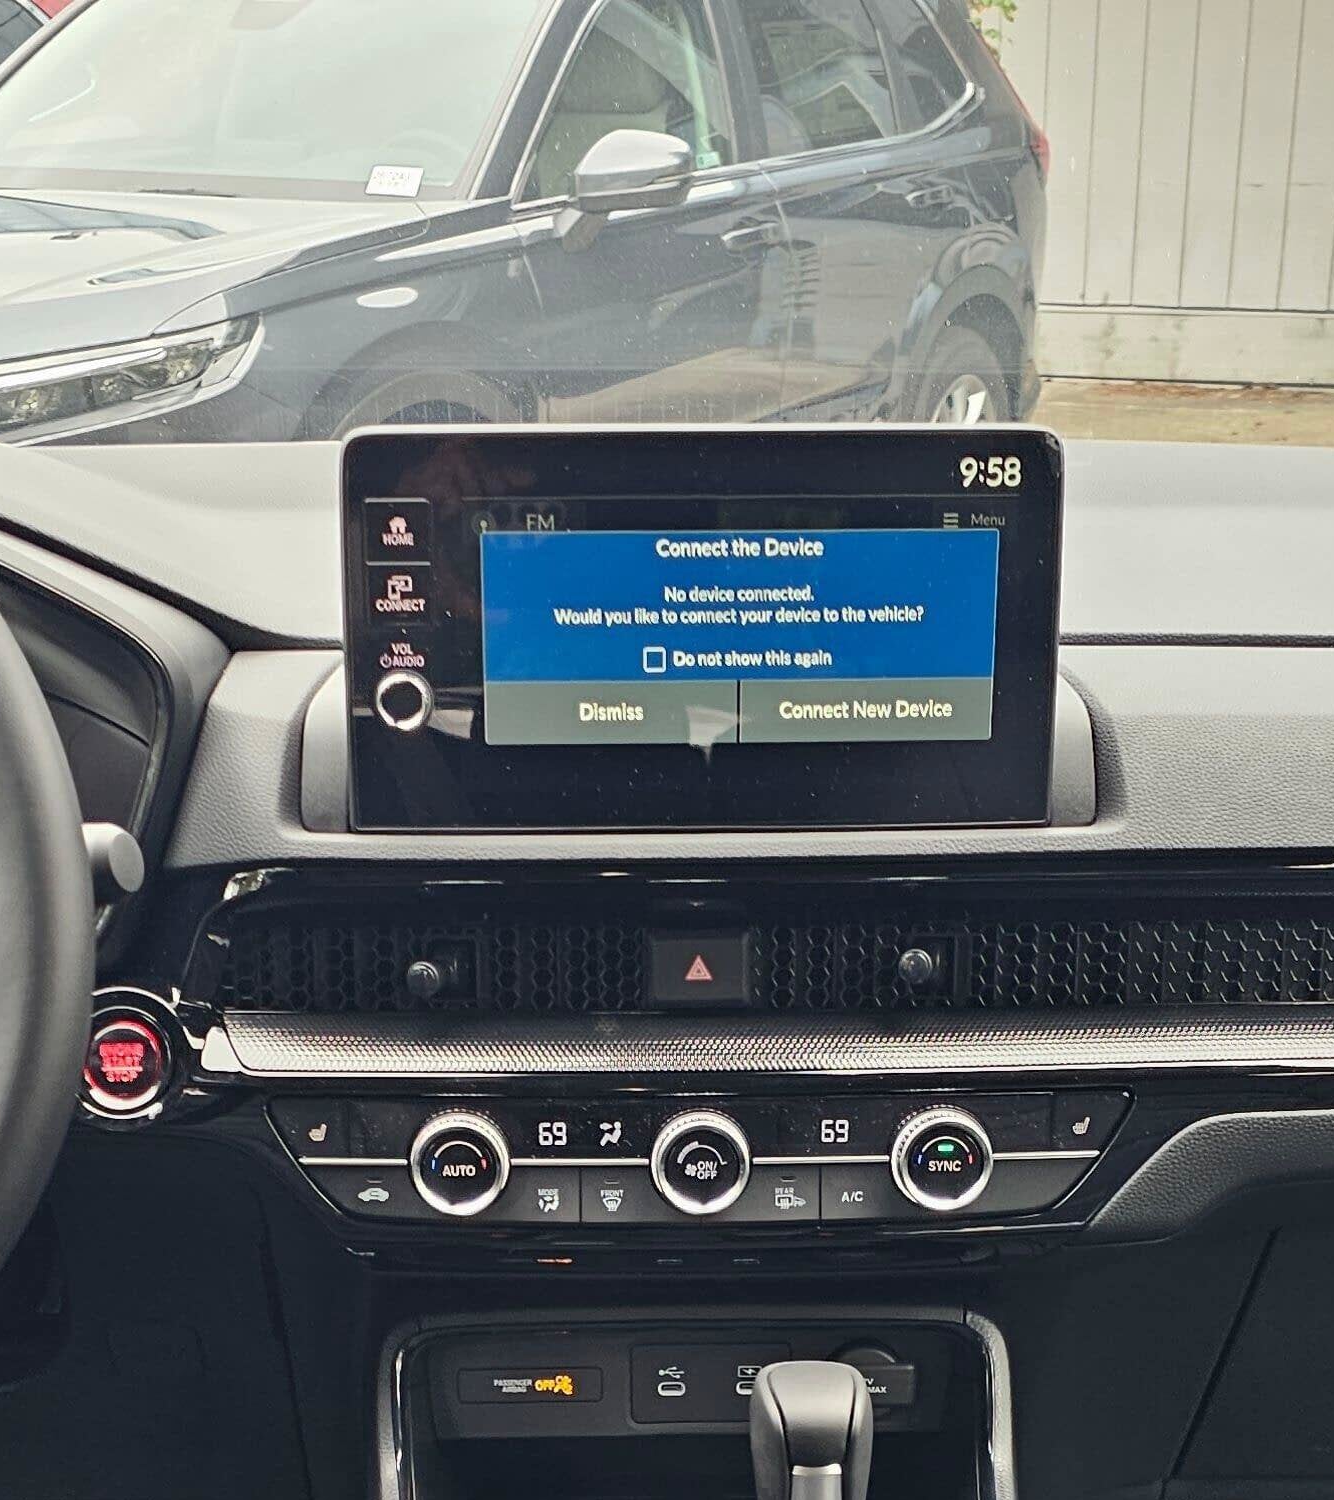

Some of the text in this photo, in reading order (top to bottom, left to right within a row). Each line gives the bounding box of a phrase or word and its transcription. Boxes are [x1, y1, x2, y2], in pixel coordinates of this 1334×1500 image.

[959, 456, 1022, 488] 9:58
[526, 513, 555, 531] FM
[970, 513, 1006, 526] Menu
[382, 533, 415, 546] HOME
[655, 537, 824, 558] Connect the Device
[664, 584, 815, 602] No device connected.
[375, 599, 426, 612] CONNECT
[553, 605, 925, 627] Would you like to connect your device to the vehicle?
[391, 643, 414, 655] VOL
[392, 655, 425, 667] AUDIO
[672, 650, 833, 668] Do not show this again
[578, 702, 644, 722] Dismiss
[778, 699, 954, 720] Connect New Device
[538, 1122, 567, 1146] 69
[820, 1120, 849, 1143] 69
[442, 1164, 476, 1177] AUTO
[697, 1161, 718, 1172] ON/
[927, 1160, 962, 1173] SYNC
[696, 1170, 718, 1180] OFF
[600, 1189, 624, 1198] FRONT
[774, 1187, 796, 1195] REAR
[841, 1190, 864, 1203] A/C
[493, 1379, 533, 1387] PASSENGER
[534, 1379, 555, 1392] OFF
